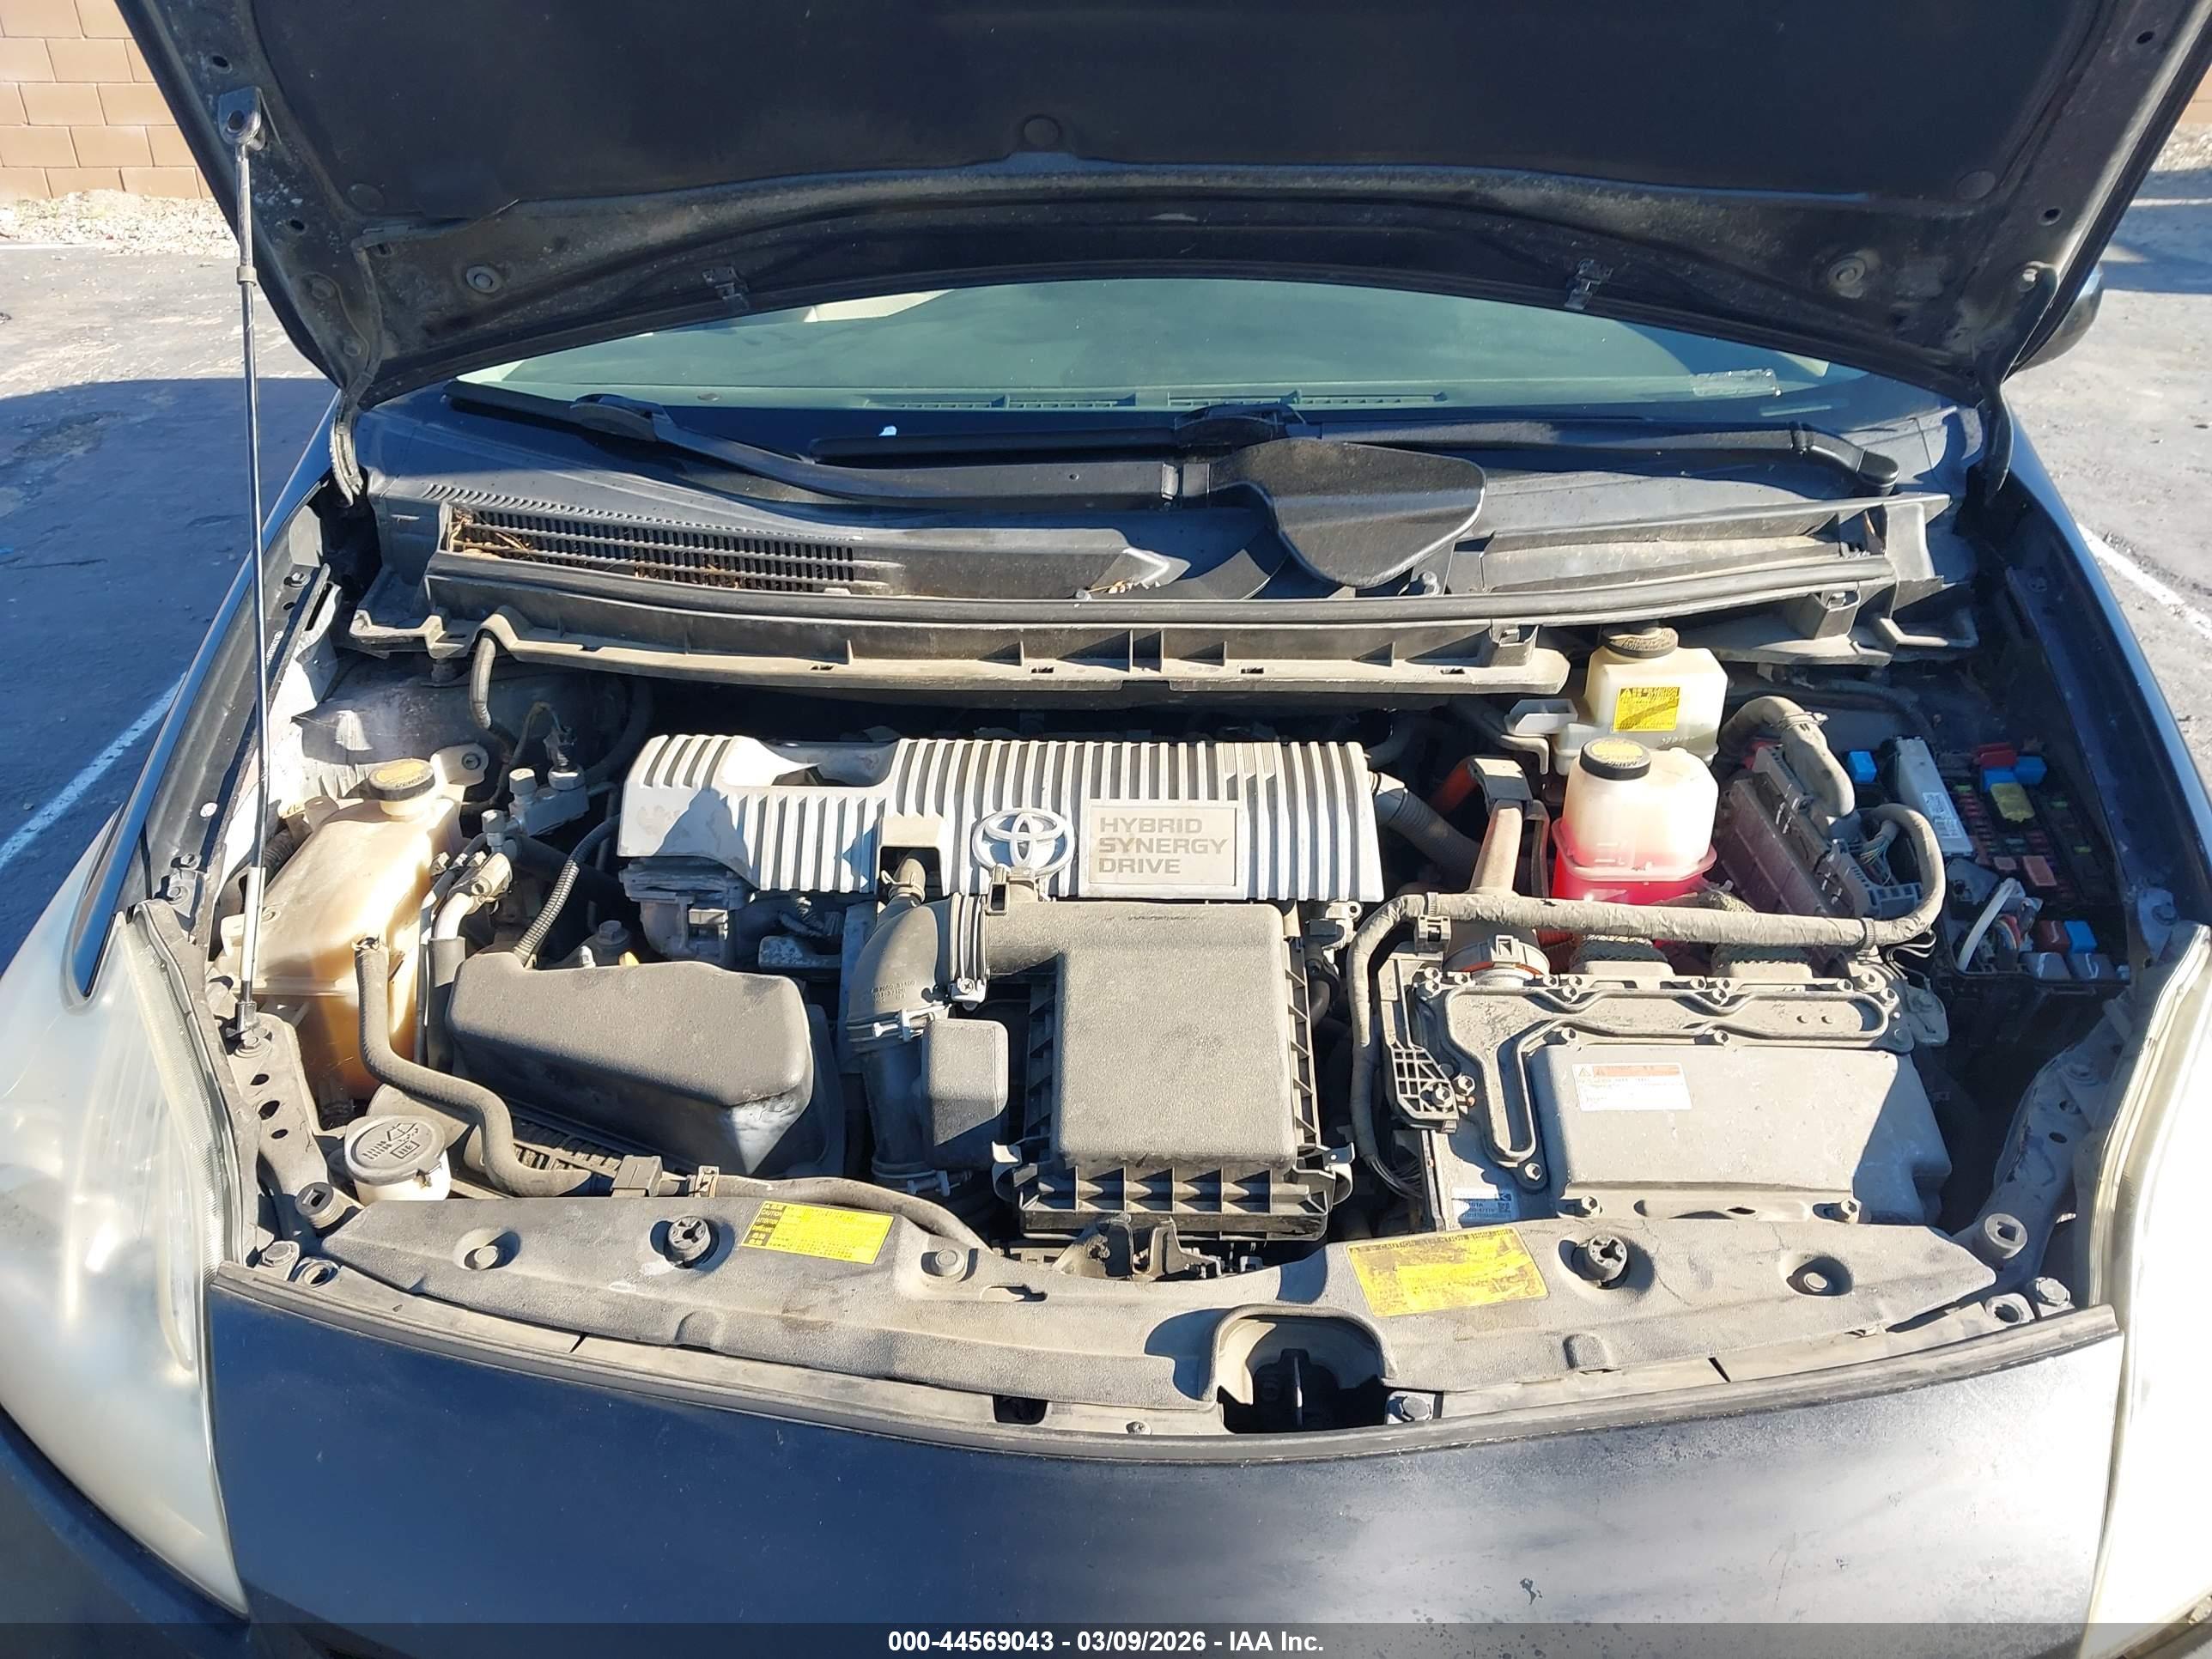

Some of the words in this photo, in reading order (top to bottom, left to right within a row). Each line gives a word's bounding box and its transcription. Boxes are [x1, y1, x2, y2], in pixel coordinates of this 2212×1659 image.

[1100, 817, 1202, 833] HYBRID
[1099, 837, 1228, 854] SYNERGY
[1099, 858, 1181, 874] DRIVE
